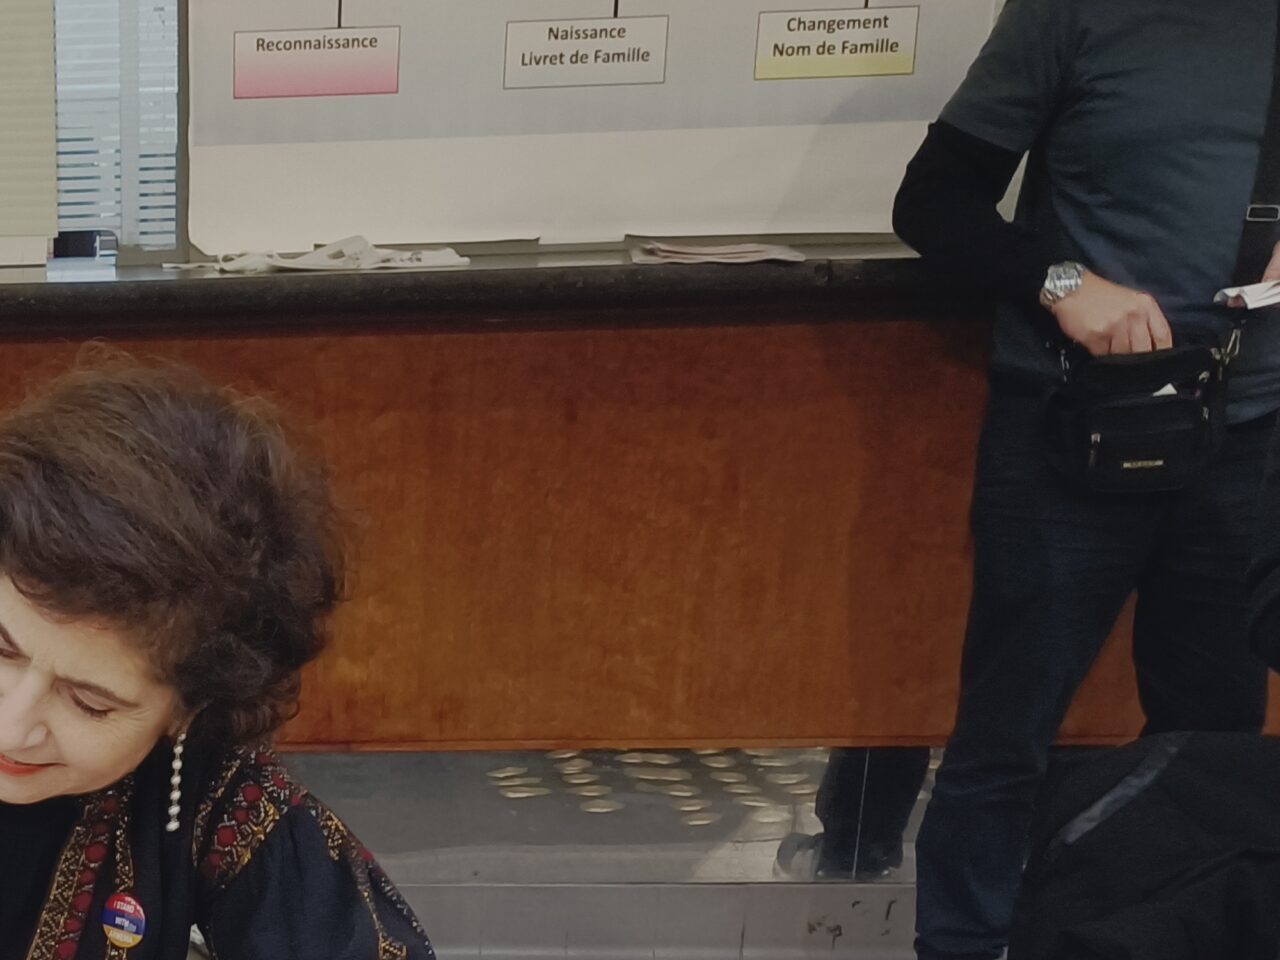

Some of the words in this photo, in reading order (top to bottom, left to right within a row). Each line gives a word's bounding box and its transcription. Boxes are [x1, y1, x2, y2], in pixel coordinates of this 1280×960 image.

[547, 24, 627, 42] Naissance
[787, 14, 890, 34] Changement
[255, 33, 379, 53] Reconnaissance
[772, 41, 812, 58] Nom
[815, 40, 836, 56] de
[840, 37, 900, 54] Famille
[520, 50, 564, 66] Livret
[569, 48, 589, 64] de
[594, 46, 651, 64] Famille
